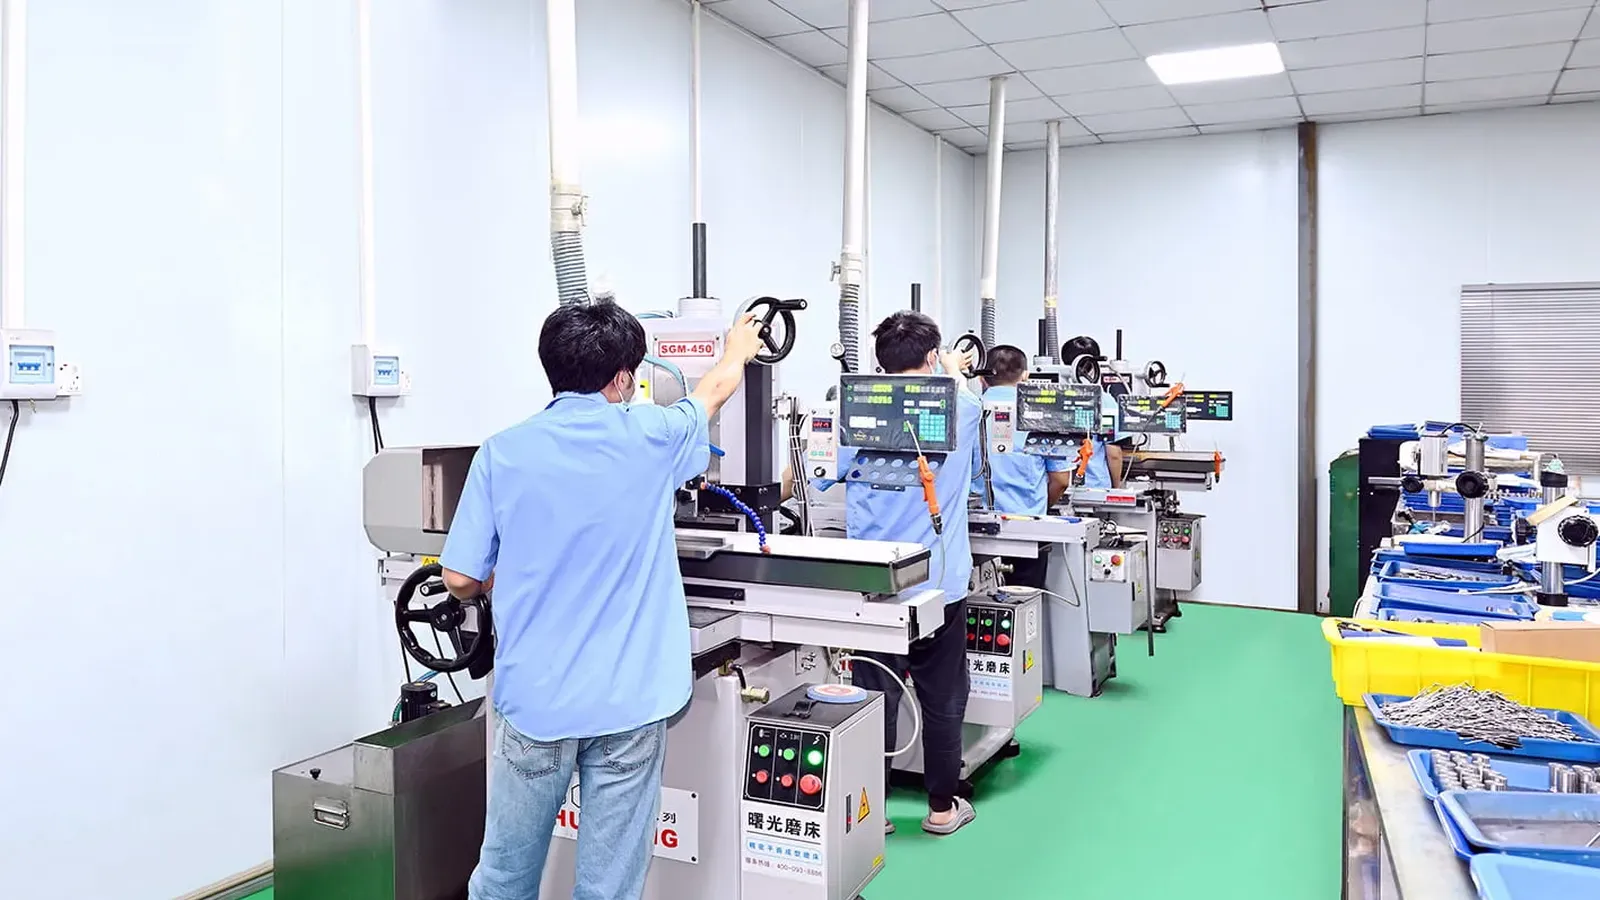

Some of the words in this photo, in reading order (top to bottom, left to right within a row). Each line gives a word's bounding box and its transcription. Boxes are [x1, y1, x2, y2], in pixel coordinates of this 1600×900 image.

[661, 344, 712, 354] SGM-450
[748, 812, 821, 840] 曙光磨床
